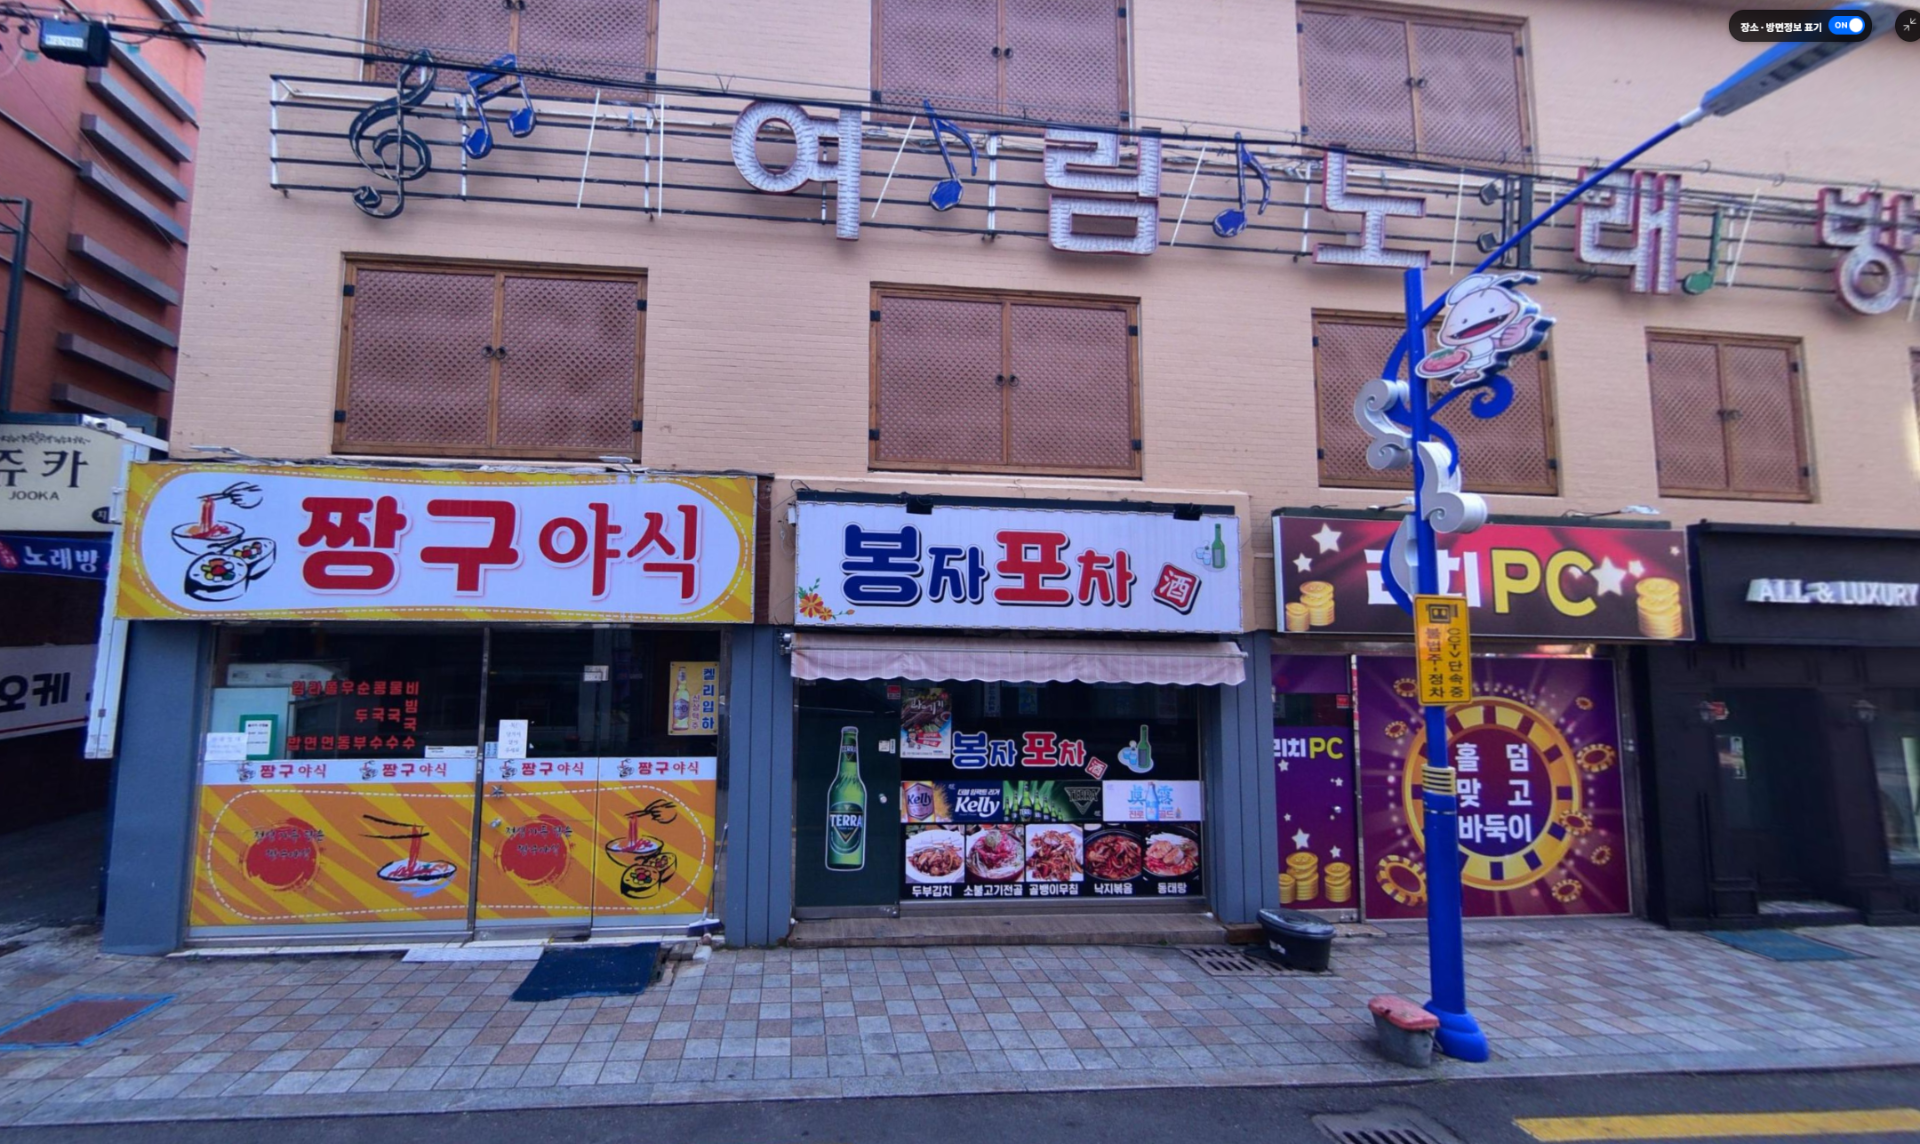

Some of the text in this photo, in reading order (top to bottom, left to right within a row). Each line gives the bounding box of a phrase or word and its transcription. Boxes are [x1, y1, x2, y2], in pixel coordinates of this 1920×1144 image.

[9, 491, 60, 501] JOOKA
[24, 545, 100, 573] 노래방
[1748, 578, 1811, 603] ALL
[1839, 581, 1919, 606] LUXURY
[955, 796, 1000, 818] Kelly
[829, 814, 863, 828] TERRA
[1458, 813, 1532, 843] 바둑이
[912, 885, 952, 897] 두부김치
[963, 884, 1024, 897] 소불고기전골
[1029, 884, 1079, 896] 골뱅이무침
[1094, 883, 1133, 895] 낙지볶음
[1157, 882, 1188, 894] 동태탕
